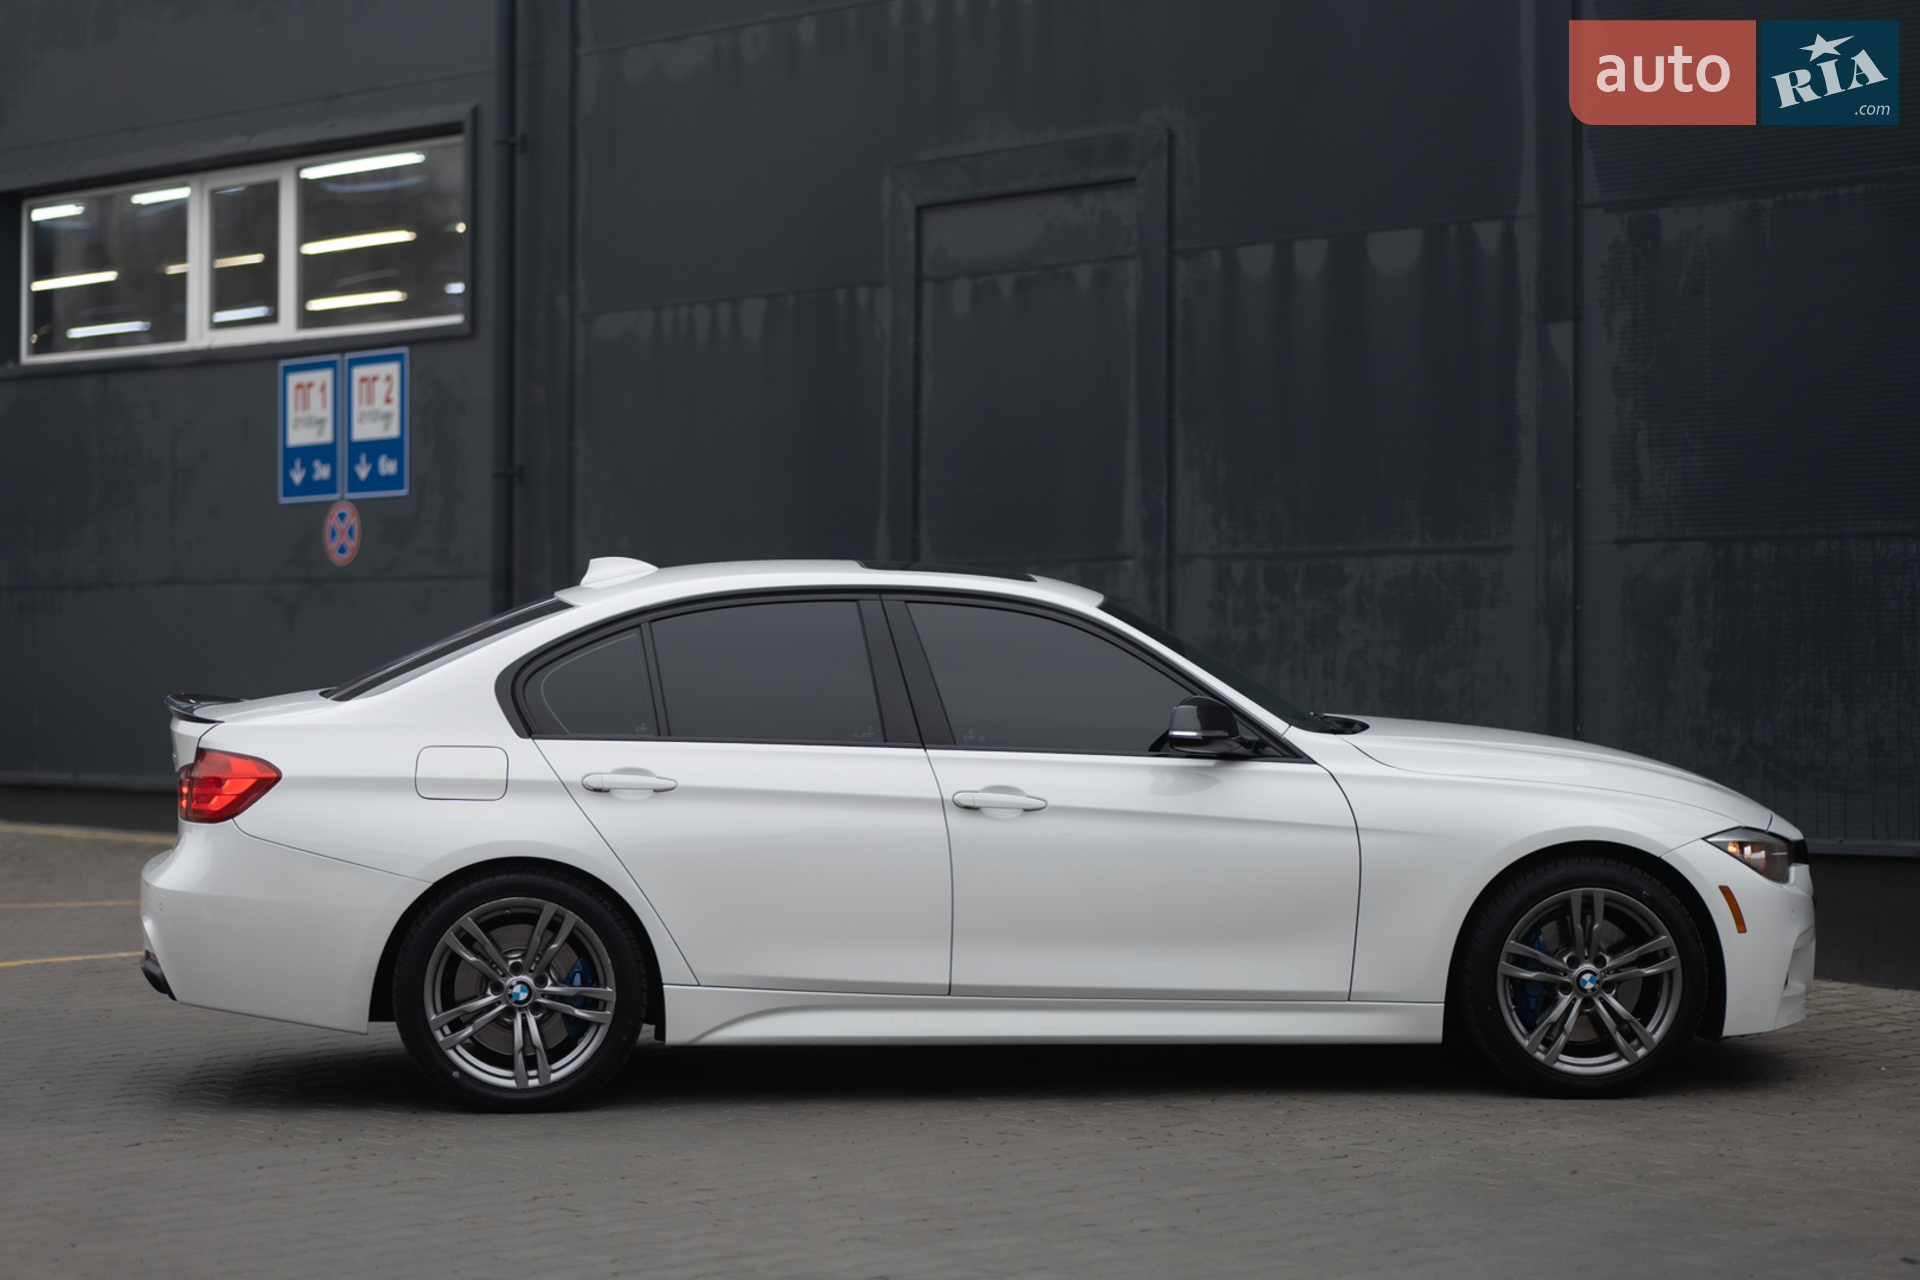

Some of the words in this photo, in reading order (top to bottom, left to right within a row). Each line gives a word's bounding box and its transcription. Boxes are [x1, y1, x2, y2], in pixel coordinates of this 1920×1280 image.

[294, 382, 315, 413] ПГ
[320, 380, 328, 411] 1
[358, 375, 381, 408] ПГ
[384, 374, 394, 406] 2
